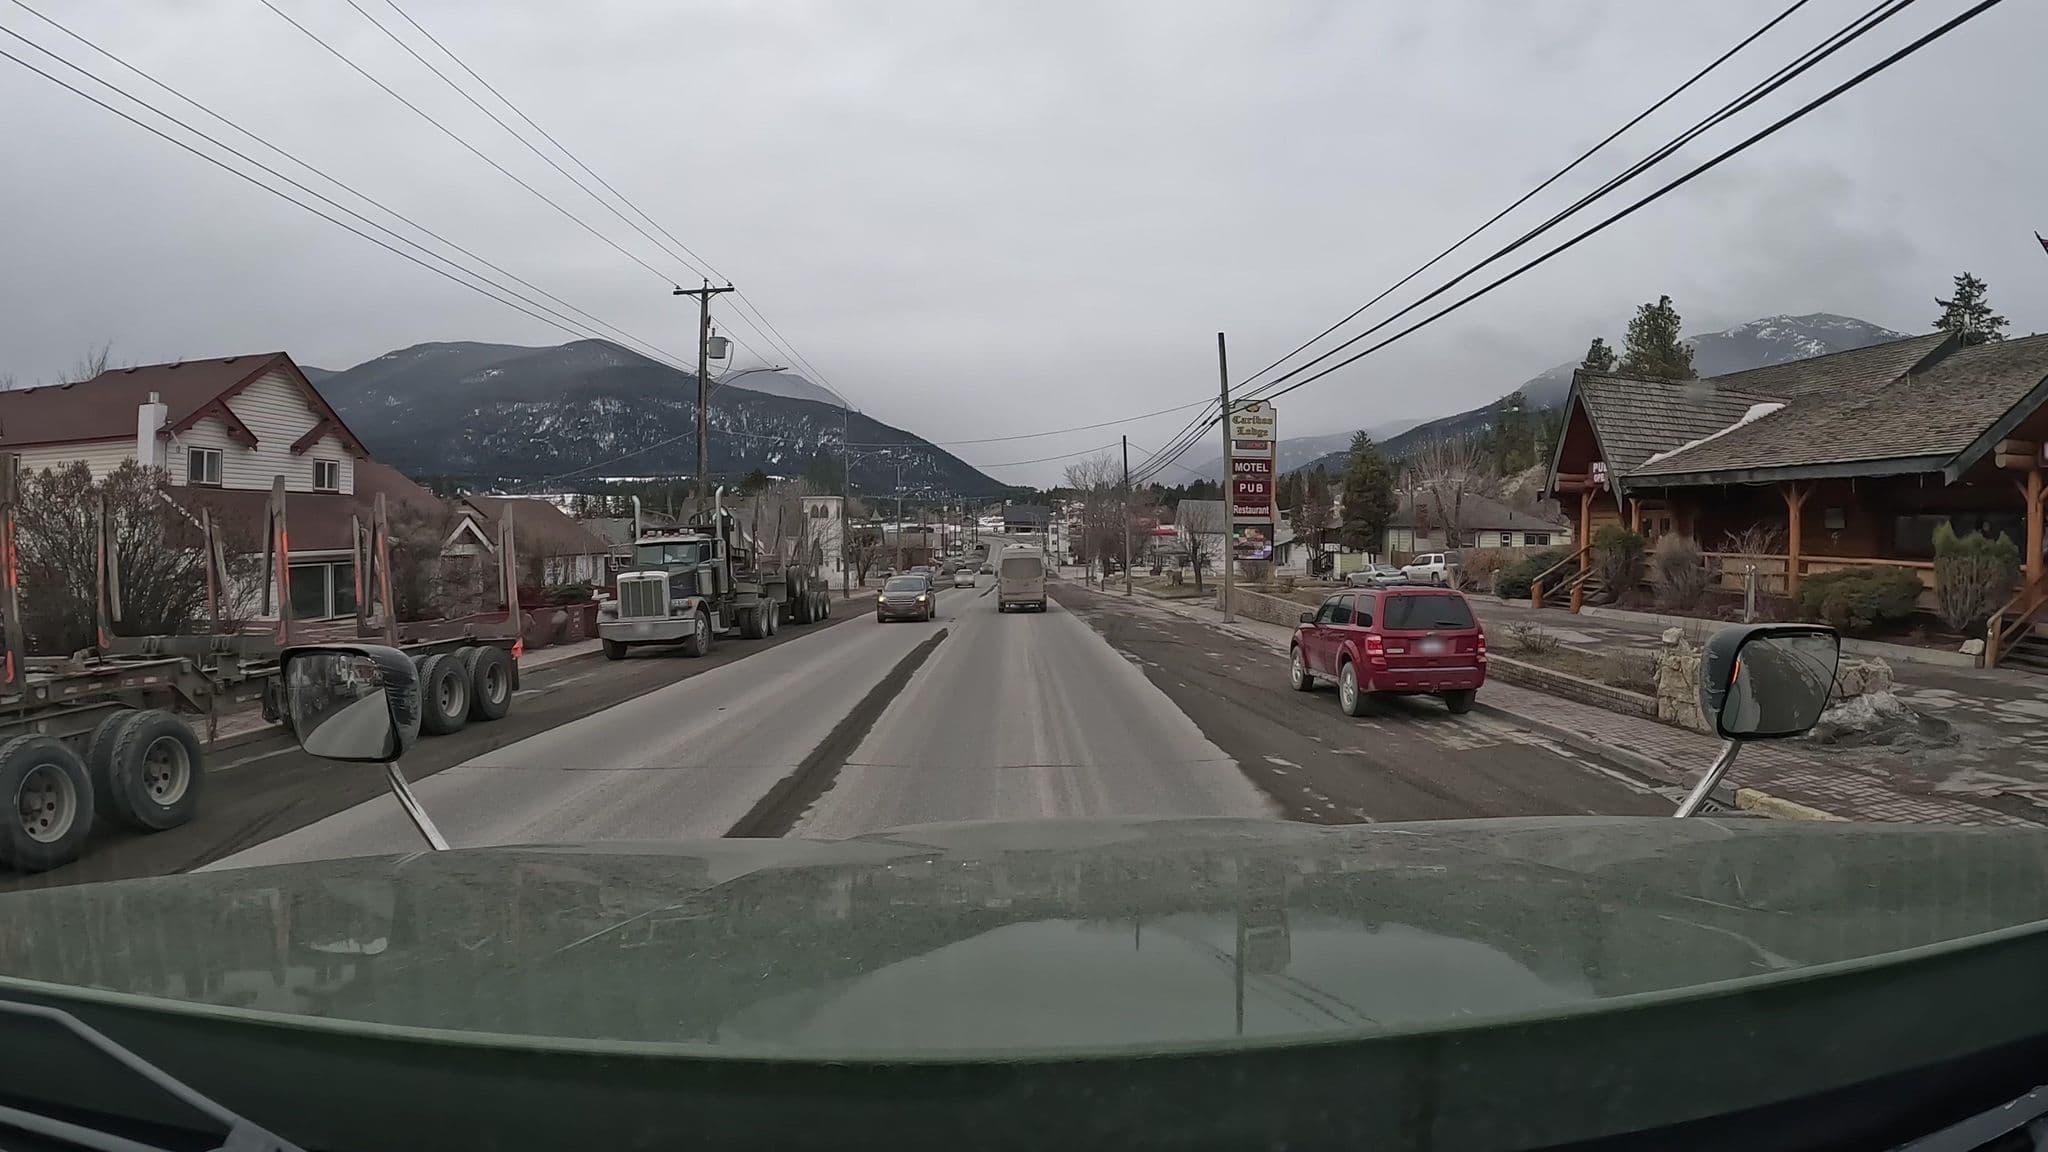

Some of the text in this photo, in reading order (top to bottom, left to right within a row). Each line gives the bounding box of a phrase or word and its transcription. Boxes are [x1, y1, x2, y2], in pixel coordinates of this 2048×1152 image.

[1234, 462, 1269, 472] MOTEL
[1239, 483, 1264, 493] PUB
[1233, 504, 1269, 514] Restaurant
